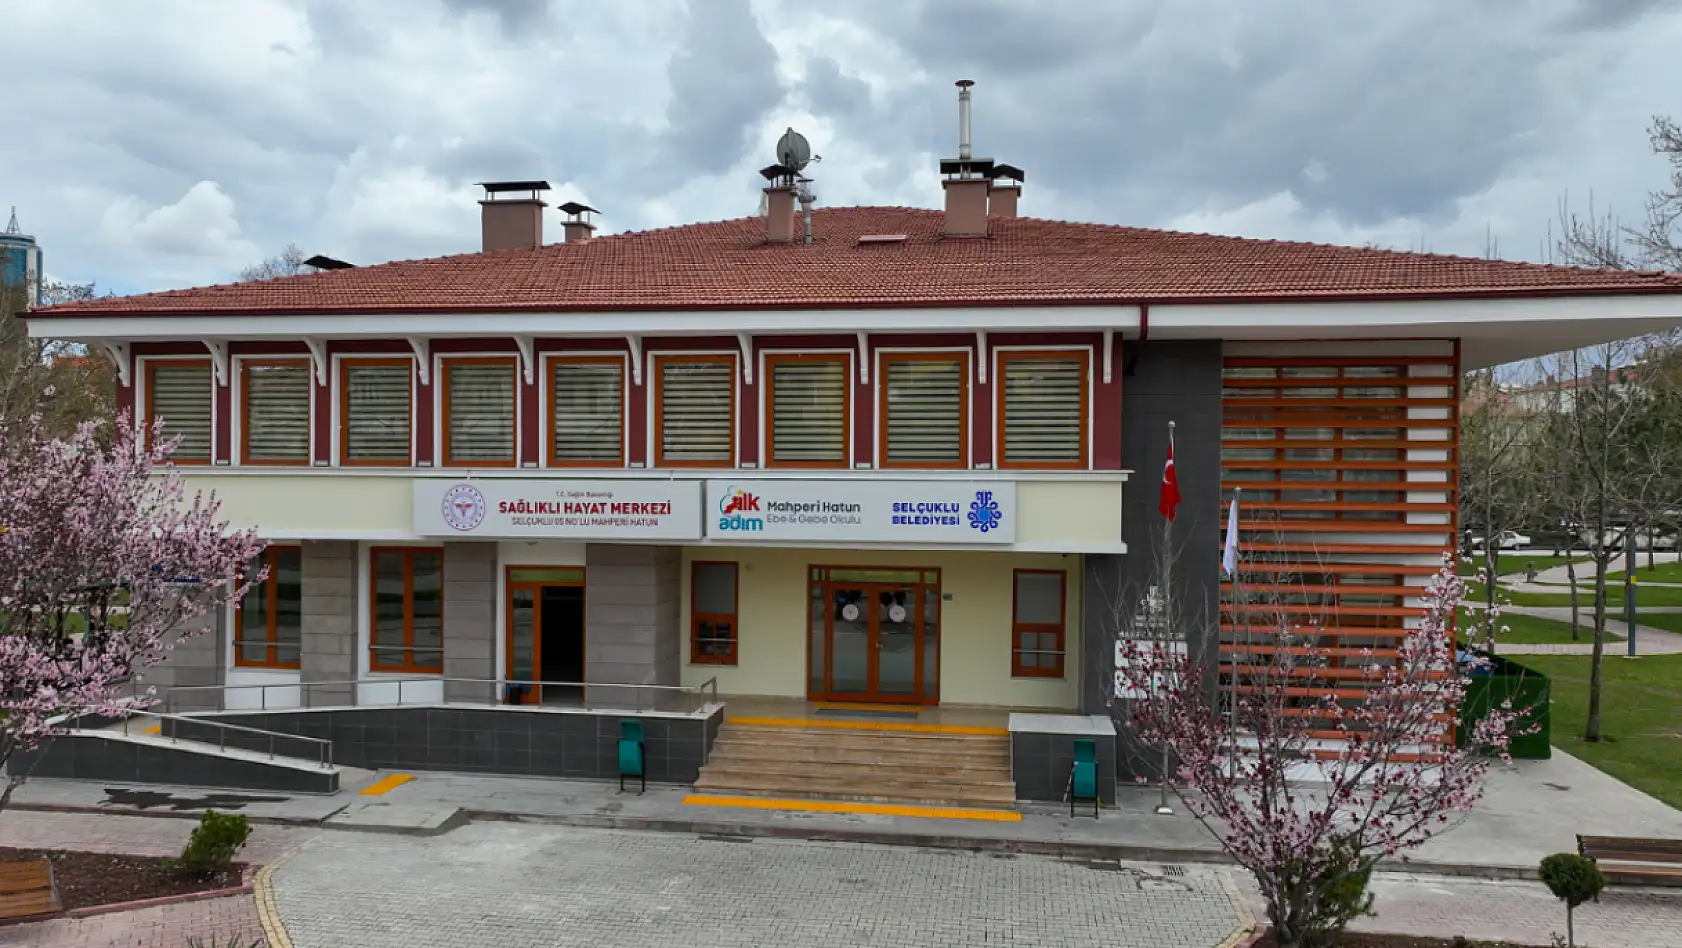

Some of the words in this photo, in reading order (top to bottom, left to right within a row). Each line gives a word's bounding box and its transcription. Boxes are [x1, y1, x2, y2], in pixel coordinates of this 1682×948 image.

[498, 498, 561, 514] SAĞLIKLI
[563, 501, 607, 515] HAYAT
[610, 500, 672, 515] MERKEZİ
[767, 500, 821, 514] Mahperi
[823, 501, 861, 513] Hatun
[892, 502, 960, 514] SELÇUKLU
[511, 517, 553, 526] SELÇUKLU
[631, 517, 659, 526] HATUN
[719, 514, 764, 531] adım
[766, 514, 786, 523] Ebe
[787, 514, 797, 523] &
[798, 514, 829, 524] Gebe
[830, 514, 862, 525] Okulu
[892, 514, 960, 526] BELEDİYESİ
